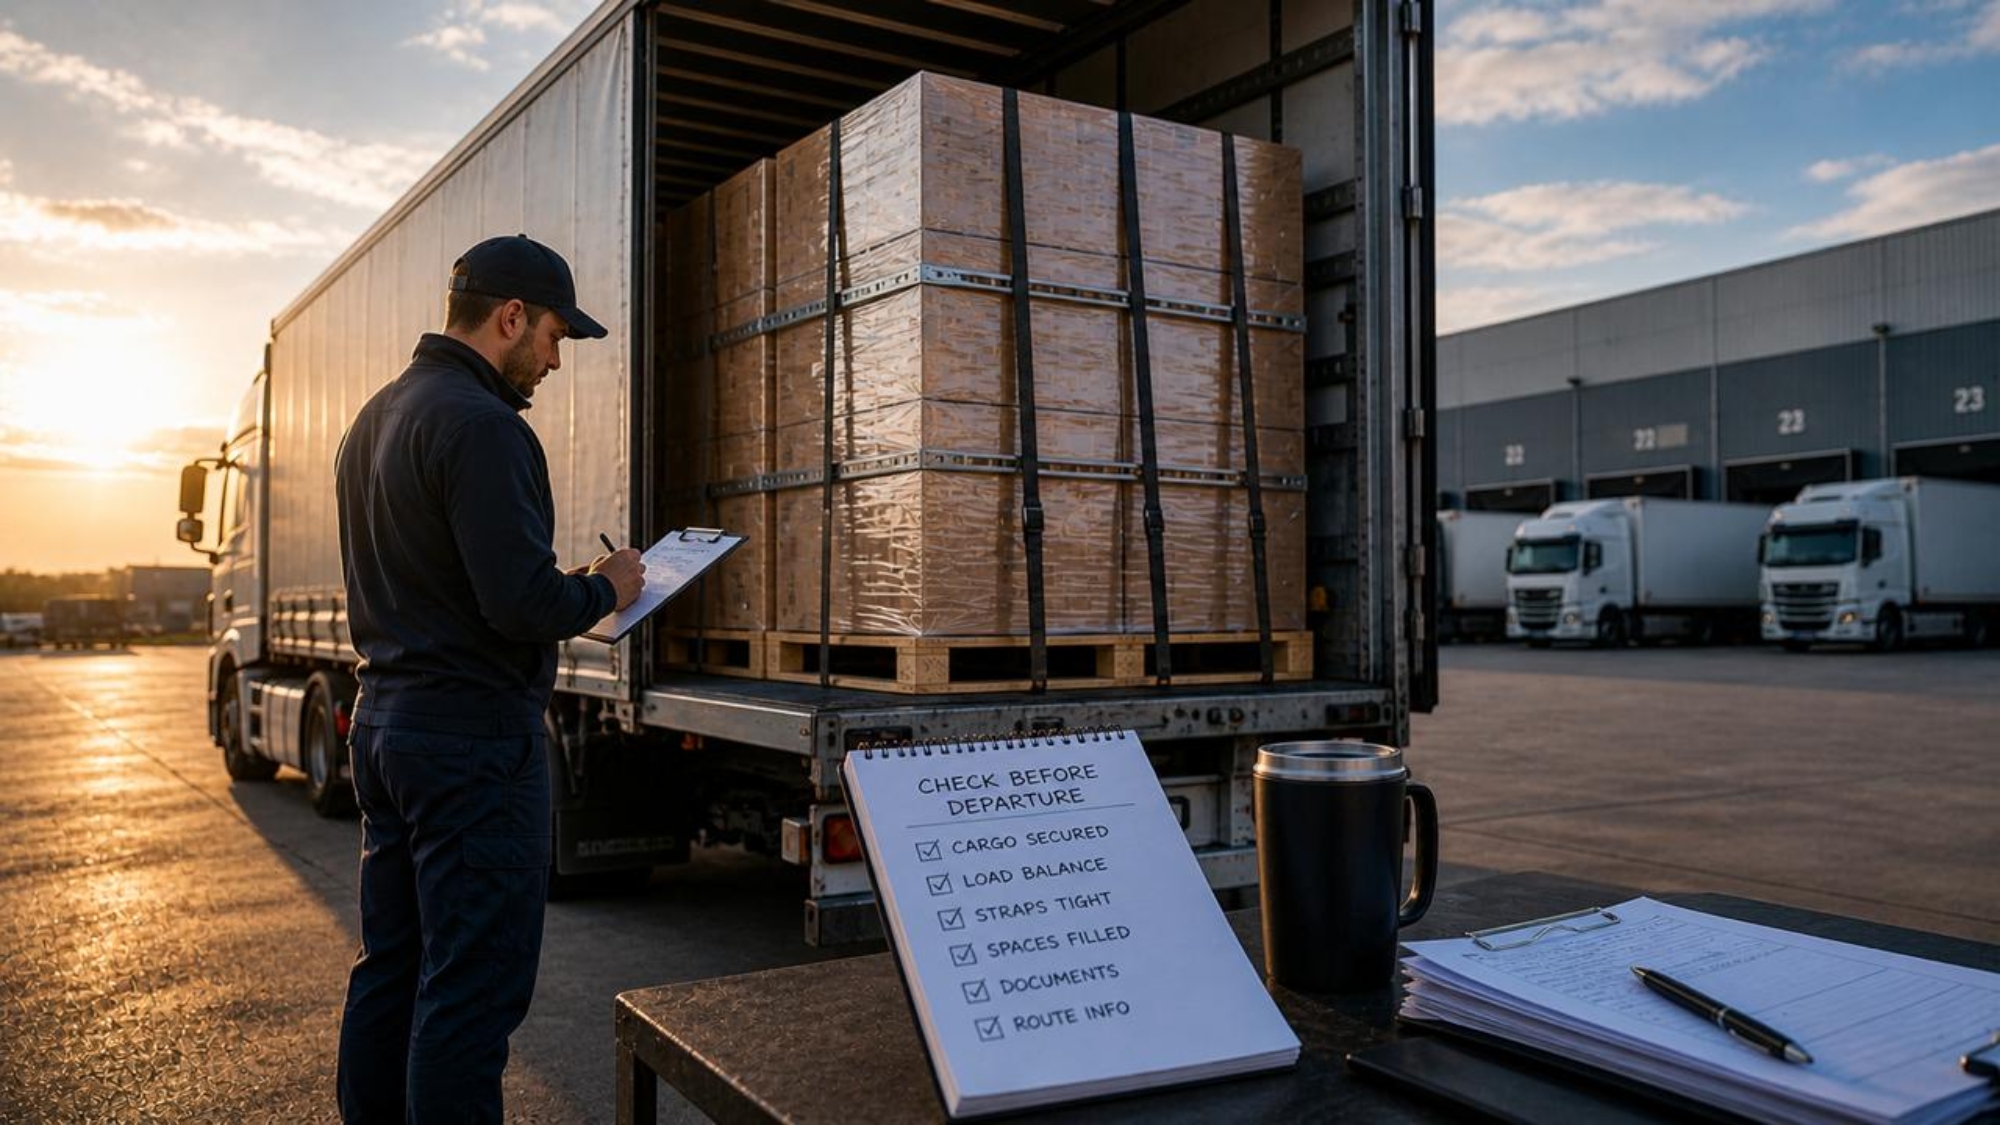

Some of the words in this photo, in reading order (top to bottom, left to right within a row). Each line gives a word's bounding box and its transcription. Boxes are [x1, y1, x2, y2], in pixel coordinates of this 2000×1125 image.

[1953, 384, 1985, 413] 23
[917, 772, 1000, 795] CHECK
[1008, 763, 1099, 787] BEFORE
[946, 787, 1086, 817] DEPARTURE
[951, 838, 1018, 856] CARGO
[1026, 825, 1109, 846] SECURED
[962, 869, 1014, 889] LOAD
[1022, 857, 1109, 881] BALANCE
[974, 900, 1048, 924] STRAPS
[1054, 891, 1111, 910] TIGHT
[986, 934, 1060, 959] SPACES
[1067, 925, 1131, 947] FILLED
[999, 963, 1120, 996] DOCUMENTS
[1012, 1008, 1078, 1032] ROUTE
[1084, 1000, 1131, 1021] INFO
